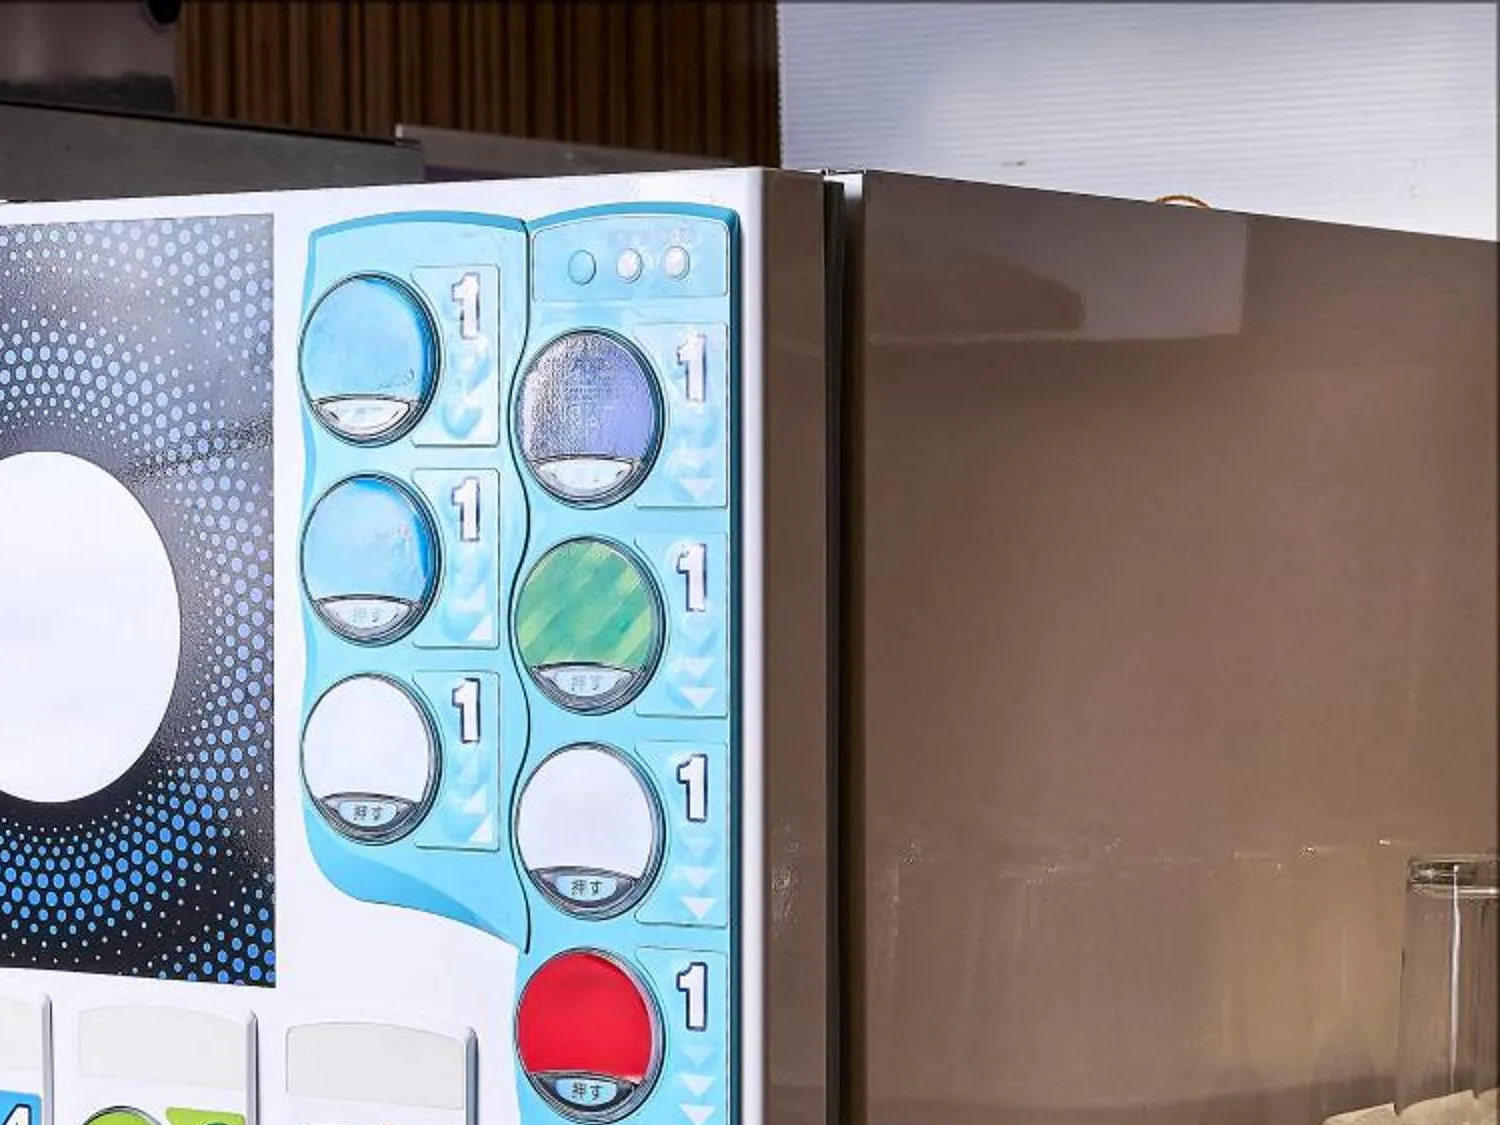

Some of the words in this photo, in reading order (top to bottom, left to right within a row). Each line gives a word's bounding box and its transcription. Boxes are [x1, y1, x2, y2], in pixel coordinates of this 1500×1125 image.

[451, 272, 481, 339] 1
[676, 333, 708, 404] 1
[451, 476, 481, 543] 1
[676, 542, 708, 612] 1
[451, 677, 481, 744] 1
[352, 804, 384, 822] 押す
[676, 753, 708, 823] 1
[570, 879, 604, 896] 押す
[676, 962, 708, 1032] 1
